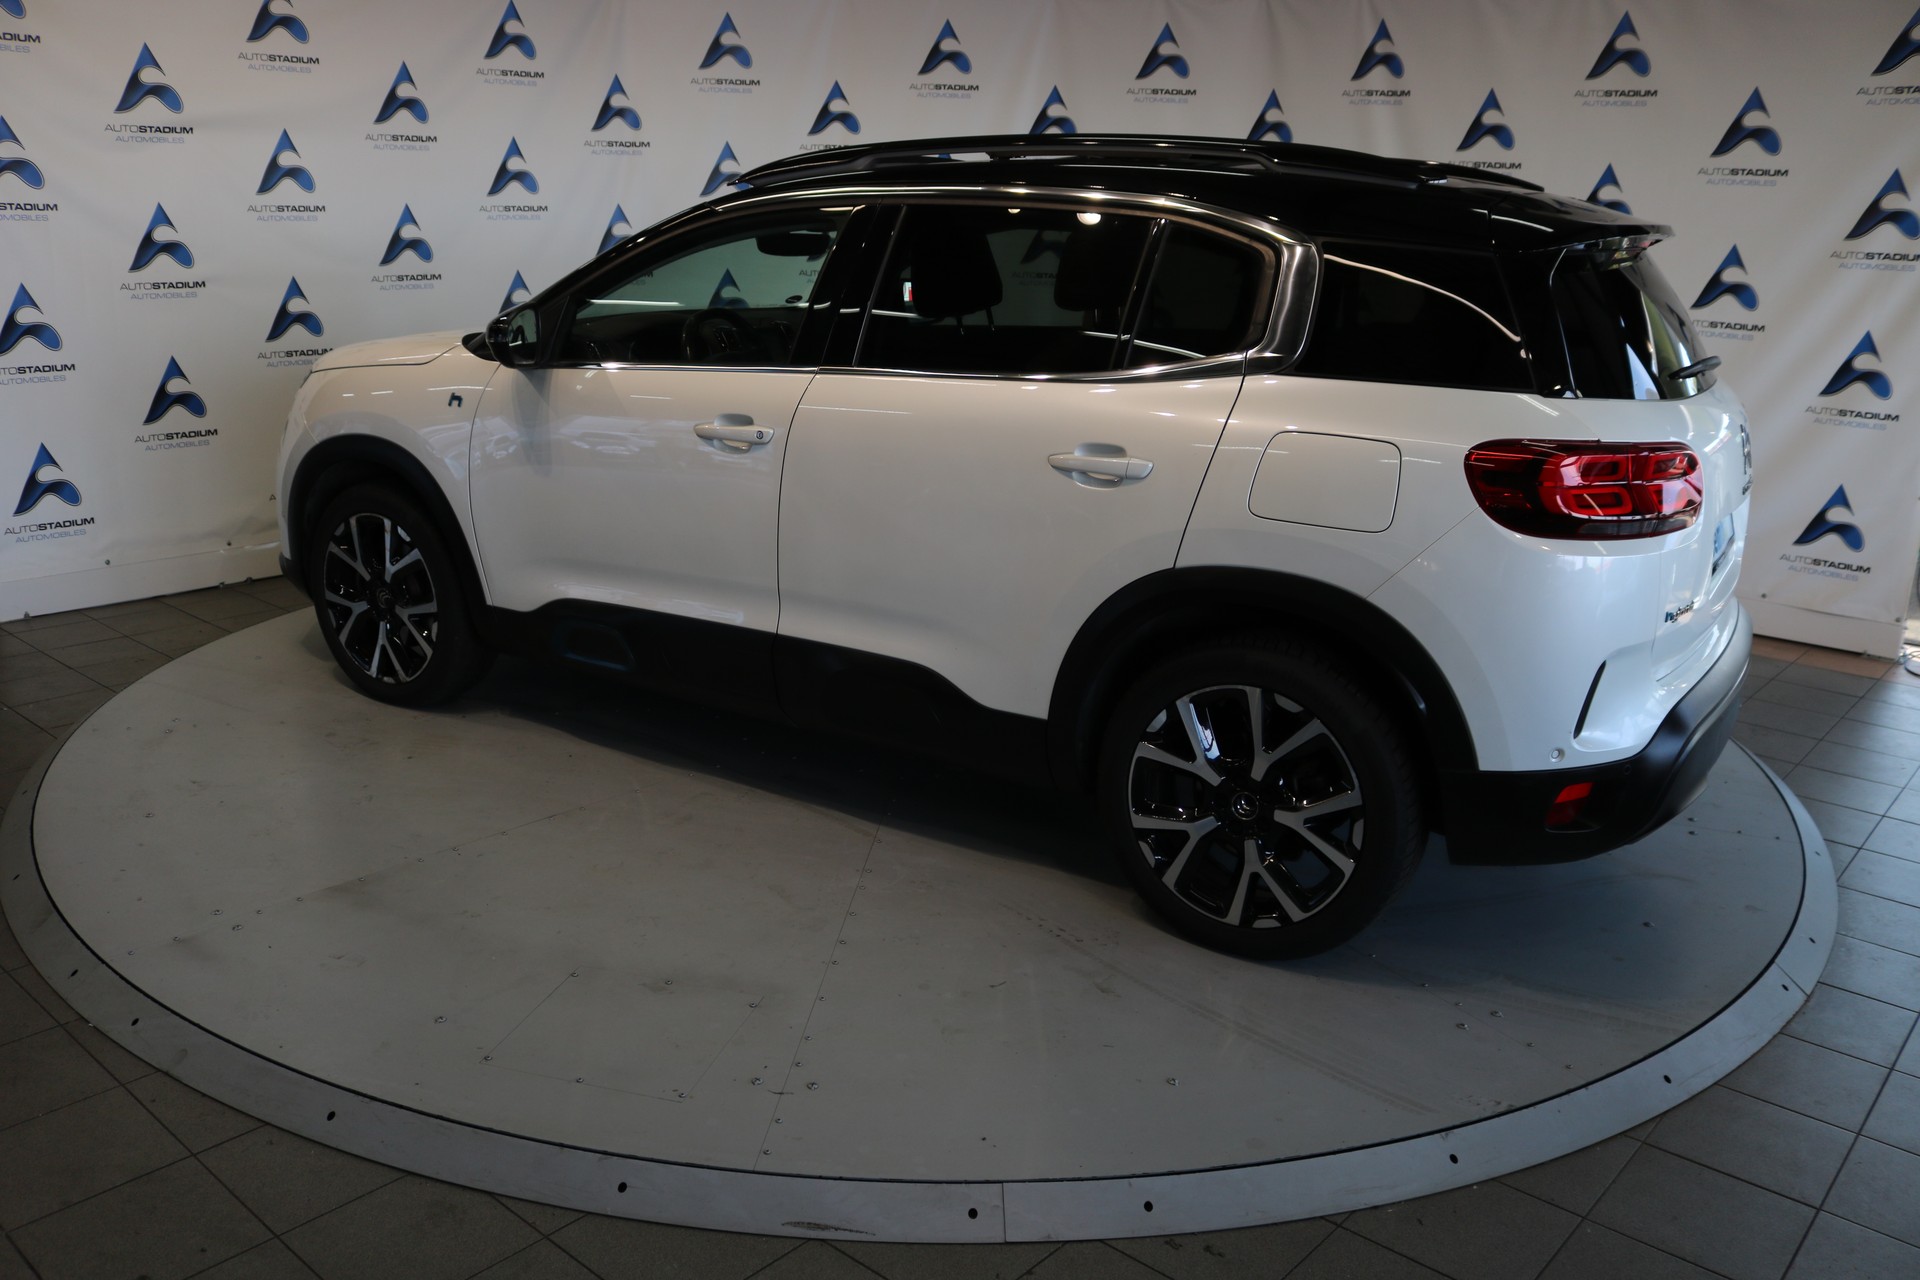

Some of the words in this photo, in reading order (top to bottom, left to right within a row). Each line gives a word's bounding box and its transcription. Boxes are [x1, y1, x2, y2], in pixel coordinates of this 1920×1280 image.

[238, 52, 320, 65] AUTOSTADIUM
[248, 63, 312, 74] AUTOMOBILES
[476, 68, 545, 79] AUTOSTADIUM
[483, 78, 536, 87] AUTOMOBILES
[690, 77, 761, 87] AUTOSTADIUM
[909, 81, 979, 92] AUTOSTADIUM
[1126, 87, 1197, 97] AUTOSTADIUM
[1342, 88, 1411, 98] AUTOSTADIUM
[1574, 88, 1658, 99] AUTOSTADIUM
[1349, 98, 1403, 106] AUTOMOBILES
[1582, 100, 1647, 109] AUTOMOBILES
[104, 123, 194, 136] AUTOSTADIUM
[115, 135, 185, 145] AUTOMOBILES
[365, 133, 438, 143] AUTOSTADIUM
[373, 144, 430, 152] AUTOMOBILES
[584, 140, 651, 149] AUTOSTADIUM
[590, 149, 644, 157] AUTOMOBILES
[1697, 165, 1789, 178] AUTOSTADIUM
[1706, 176, 1778, 187] AUTOMOBILES
[247, 204, 326, 213] AUTOSTADIUM
[479, 204, 548, 212] AUTOSTADIUM
[257, 213, 318, 222] AUTOMOBILES
[487, 213, 541, 221] AUTOMOBILES
[1838, 261, 1916, 272] AUTOMOBILES
[370, 273, 442, 283] AUTOSTADIUM
[120, 281, 206, 291] AUTOSTADIUM
[379, 282, 434, 291] AUTOMOBILES
[130, 290, 199, 301] AUTOMOBILES
[1805, 404, 1900, 423] AUTOSTADIUM
[1813, 414, 1887, 432] AUTOMOBILES
[135, 428, 218, 445] AUTOSTADIUM
[144, 438, 210, 453] AUTOMOBILES
[3, 517, 95, 536] AUTOSTADIUM
[15, 526, 87, 544] AUTOMOBILES
[1780, 553, 1871, 574] AUTOSTADIUM
[1788, 562, 1859, 583] AUTOMOBILES
